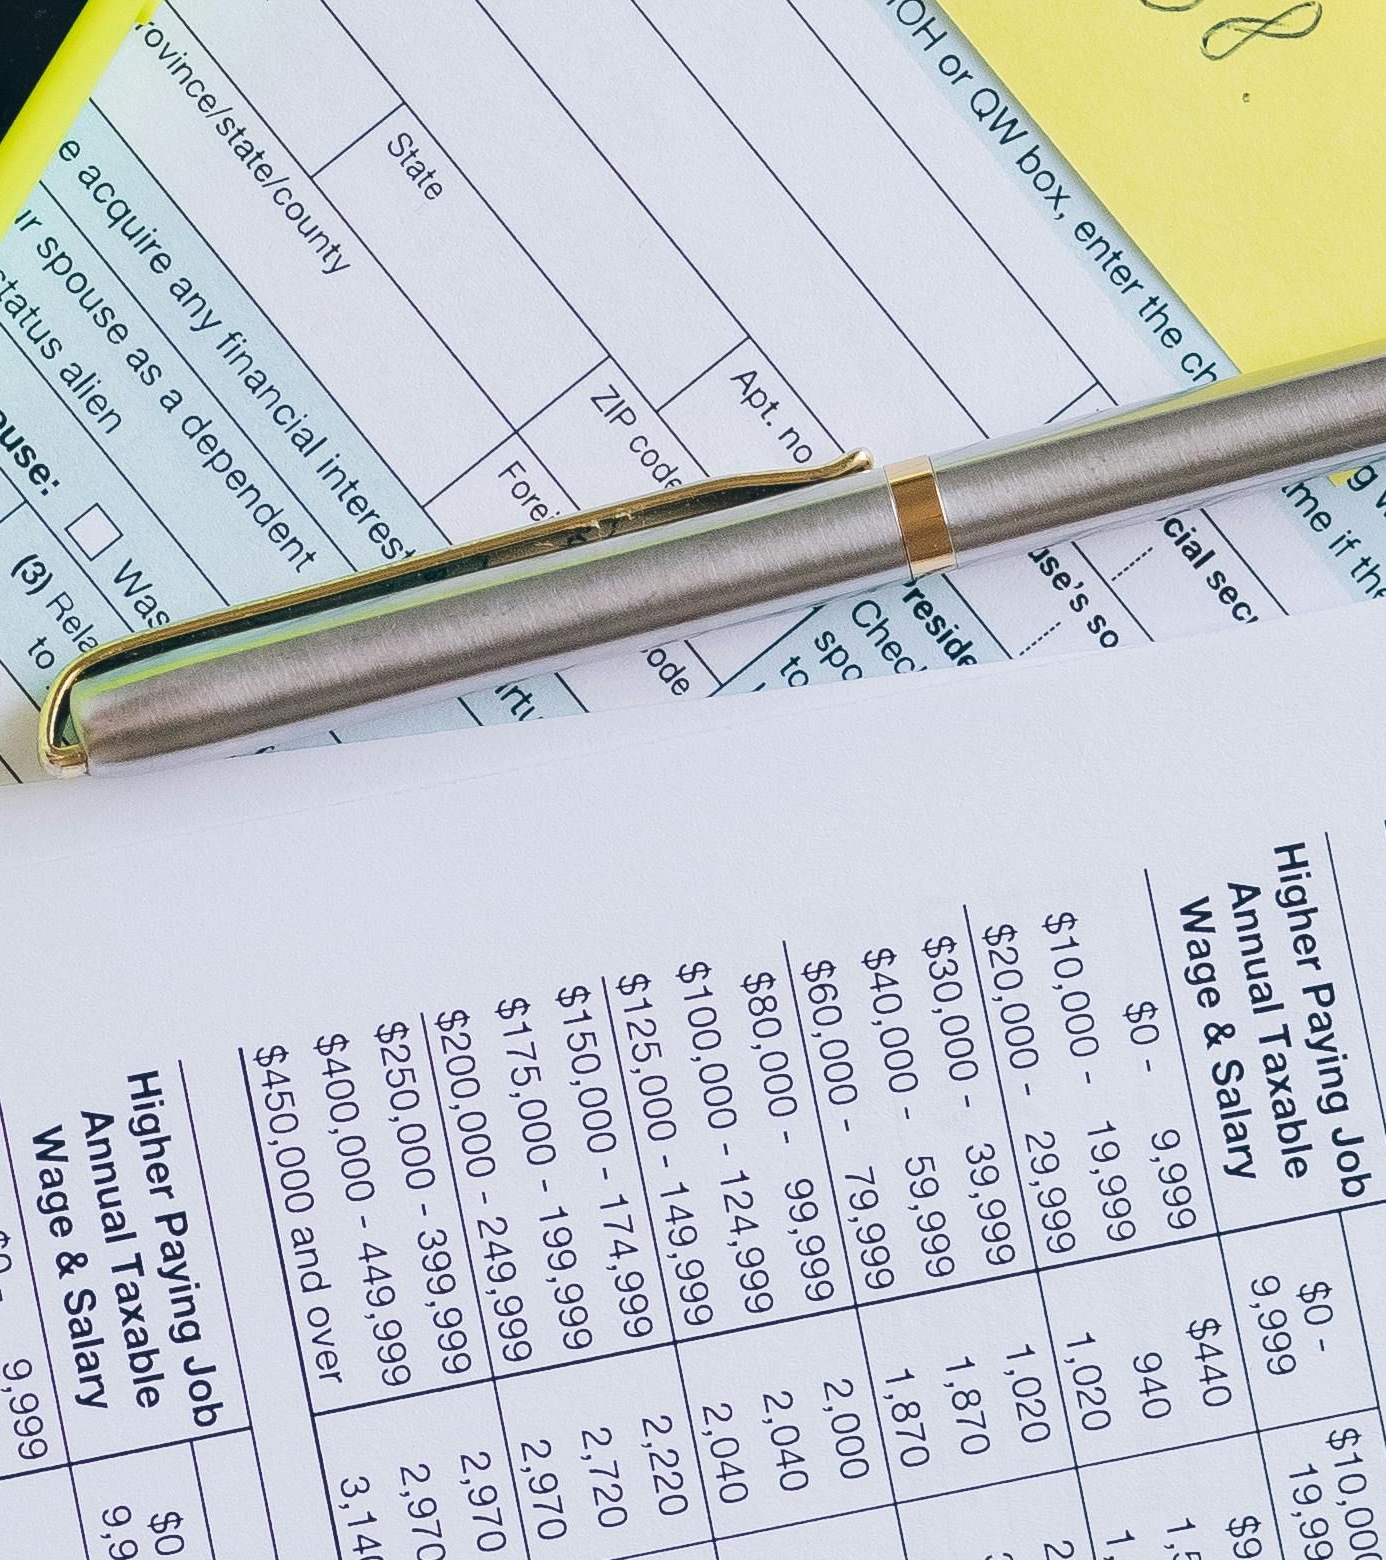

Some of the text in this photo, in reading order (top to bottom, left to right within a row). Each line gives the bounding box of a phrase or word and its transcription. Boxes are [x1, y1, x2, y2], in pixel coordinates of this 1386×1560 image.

[386, 131, 444, 202] State
[937, 53, 974, 86] or
[969, 87, 1030, 146] QW
[1014, 143, 1072, 221] box,
[1073, 220, 1145, 296] enter
[1137, 294, 1184, 350] the
[76, 164, 329, 459] acquire any financial
[35, 235, 318, 575] spouse as a dependent
[58, 361, 123, 435] alien
[589, 382, 638, 427] ZIP
[9, 552, 55, 597] (3)
[1185, 1316, 1233, 1408] $440
